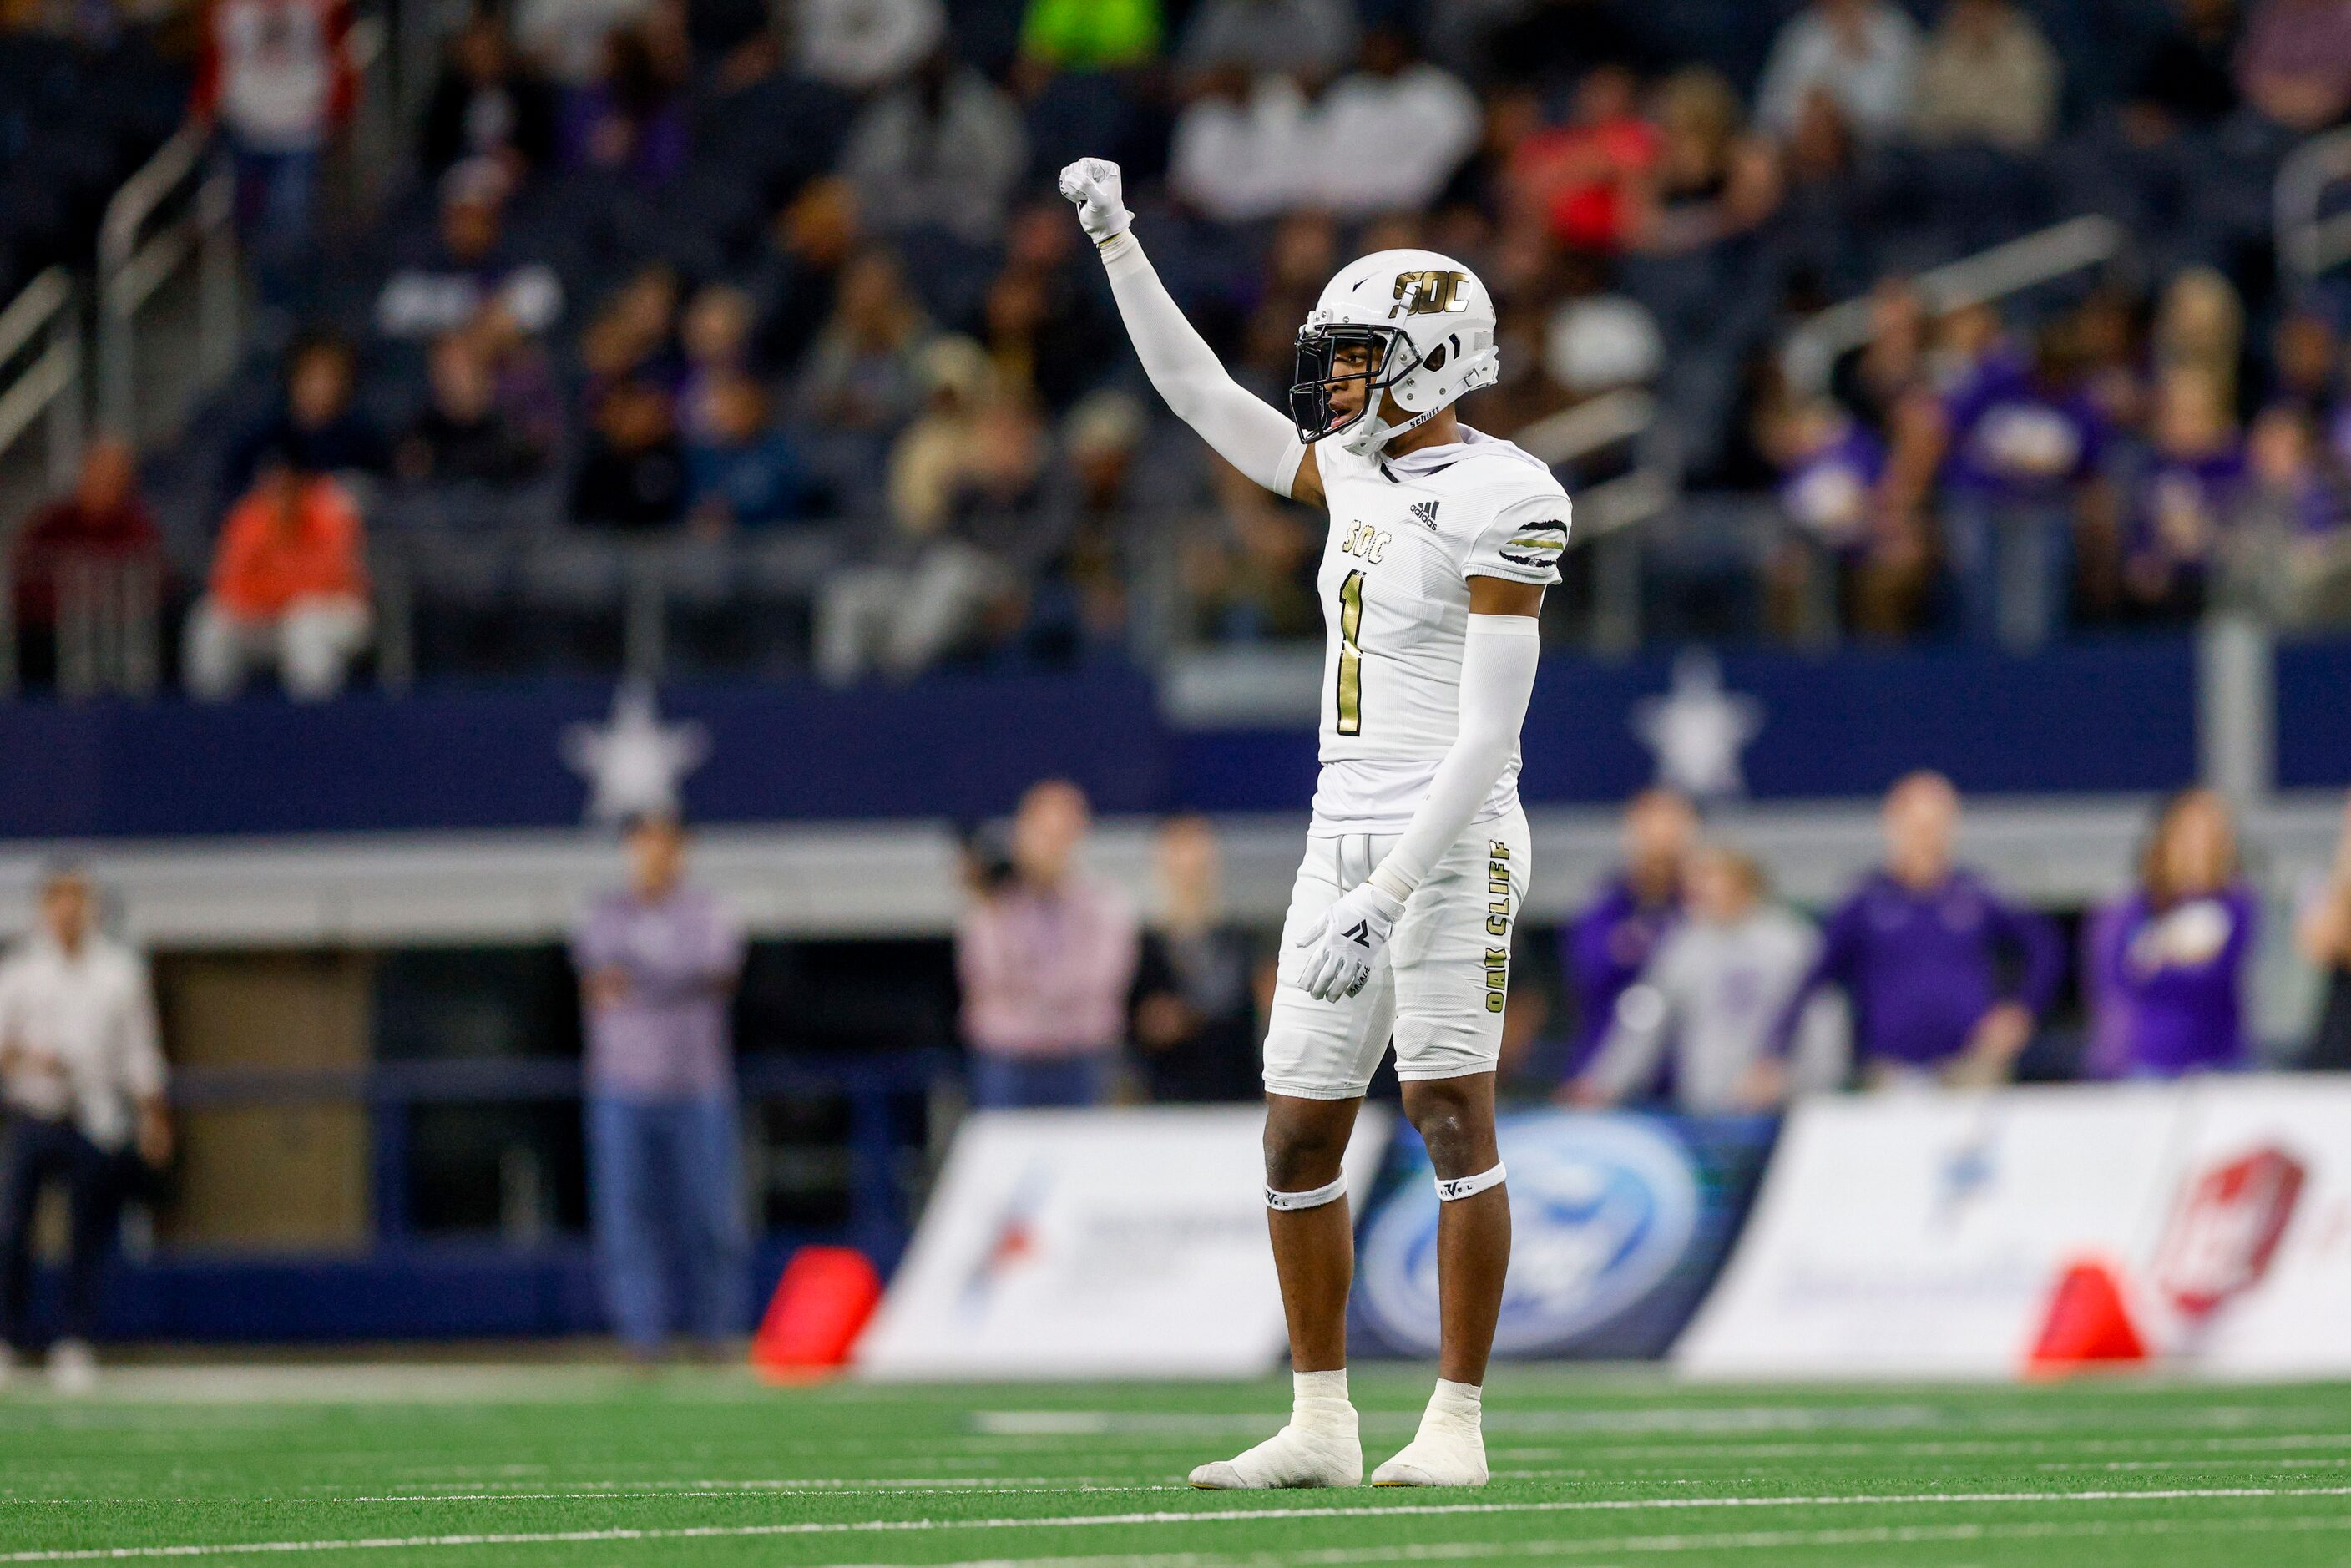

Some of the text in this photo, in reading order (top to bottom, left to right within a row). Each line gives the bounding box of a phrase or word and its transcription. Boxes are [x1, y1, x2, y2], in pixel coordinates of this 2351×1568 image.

[1388, 271, 1469, 319] SOC
[1409, 406, 1440, 428] schutt
[1410, 503, 1438, 531] adidas
[1342, 519, 1392, 564] SOC
[1336, 569, 1367, 736] 1
[1484, 839, 1509, 1013] OAK CLIFF
